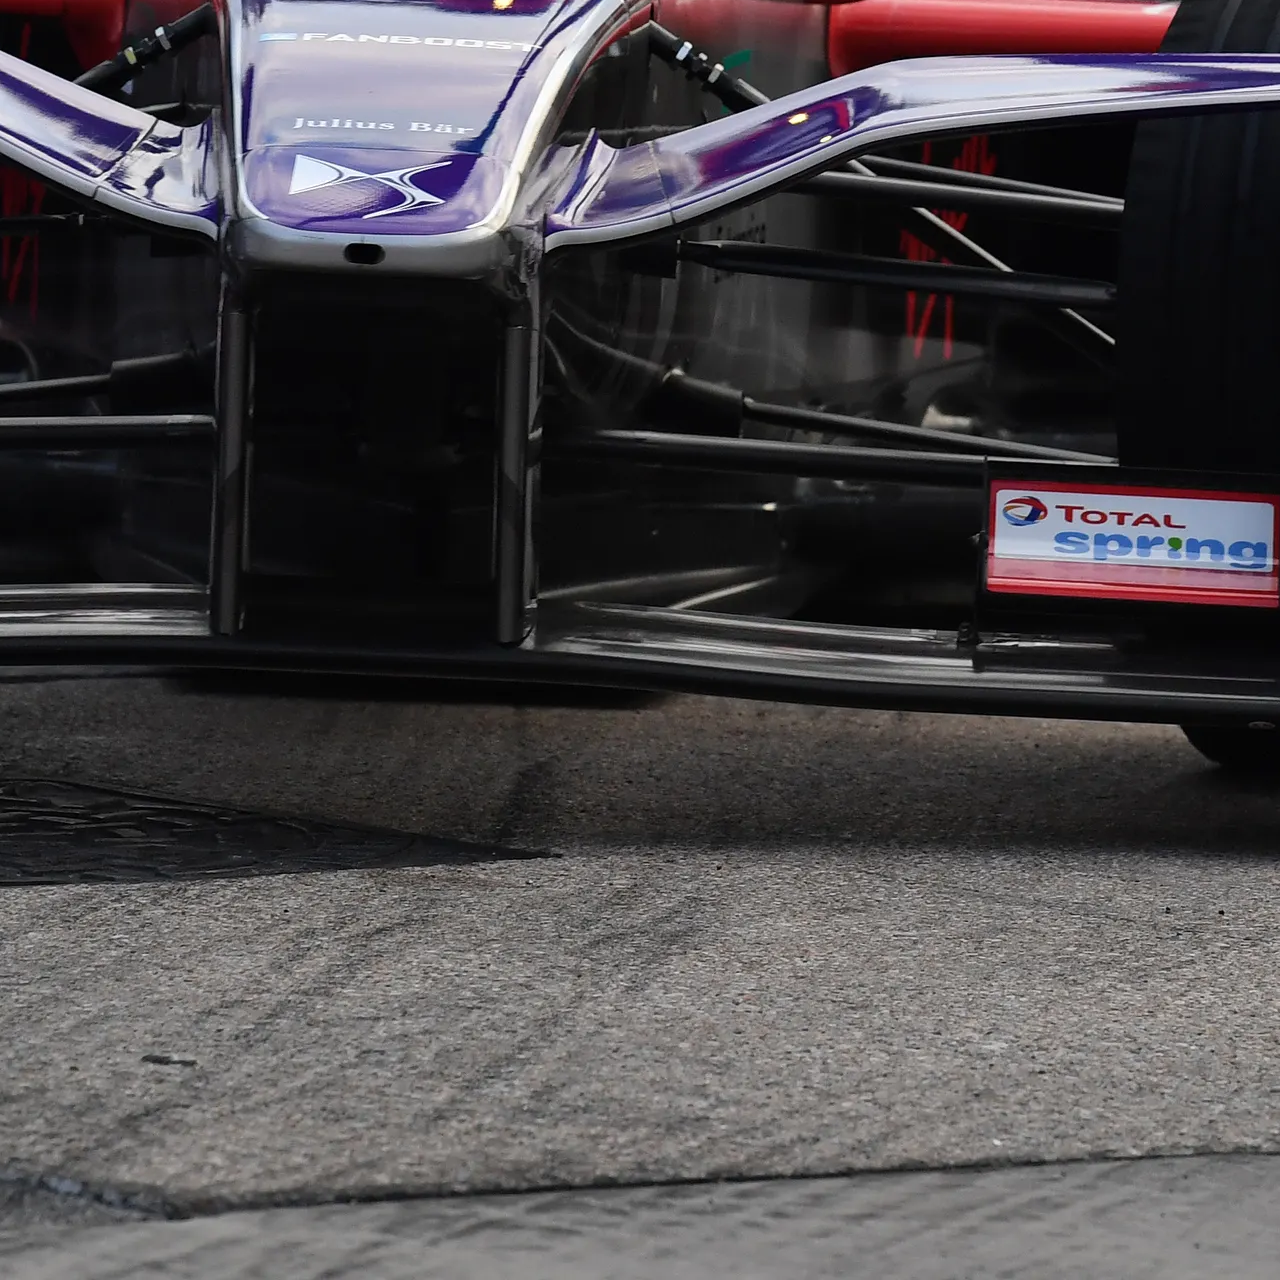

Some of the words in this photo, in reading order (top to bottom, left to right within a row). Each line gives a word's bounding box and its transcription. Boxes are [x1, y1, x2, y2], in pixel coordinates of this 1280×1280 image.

[302, 32, 542, 52] FANBOOST
[292, 116, 395, 130] Julius
[408, 121, 475, 135] Bär
[1055, 505, 1187, 529] TOTAL
[1053, 531, 1269, 570] spring
